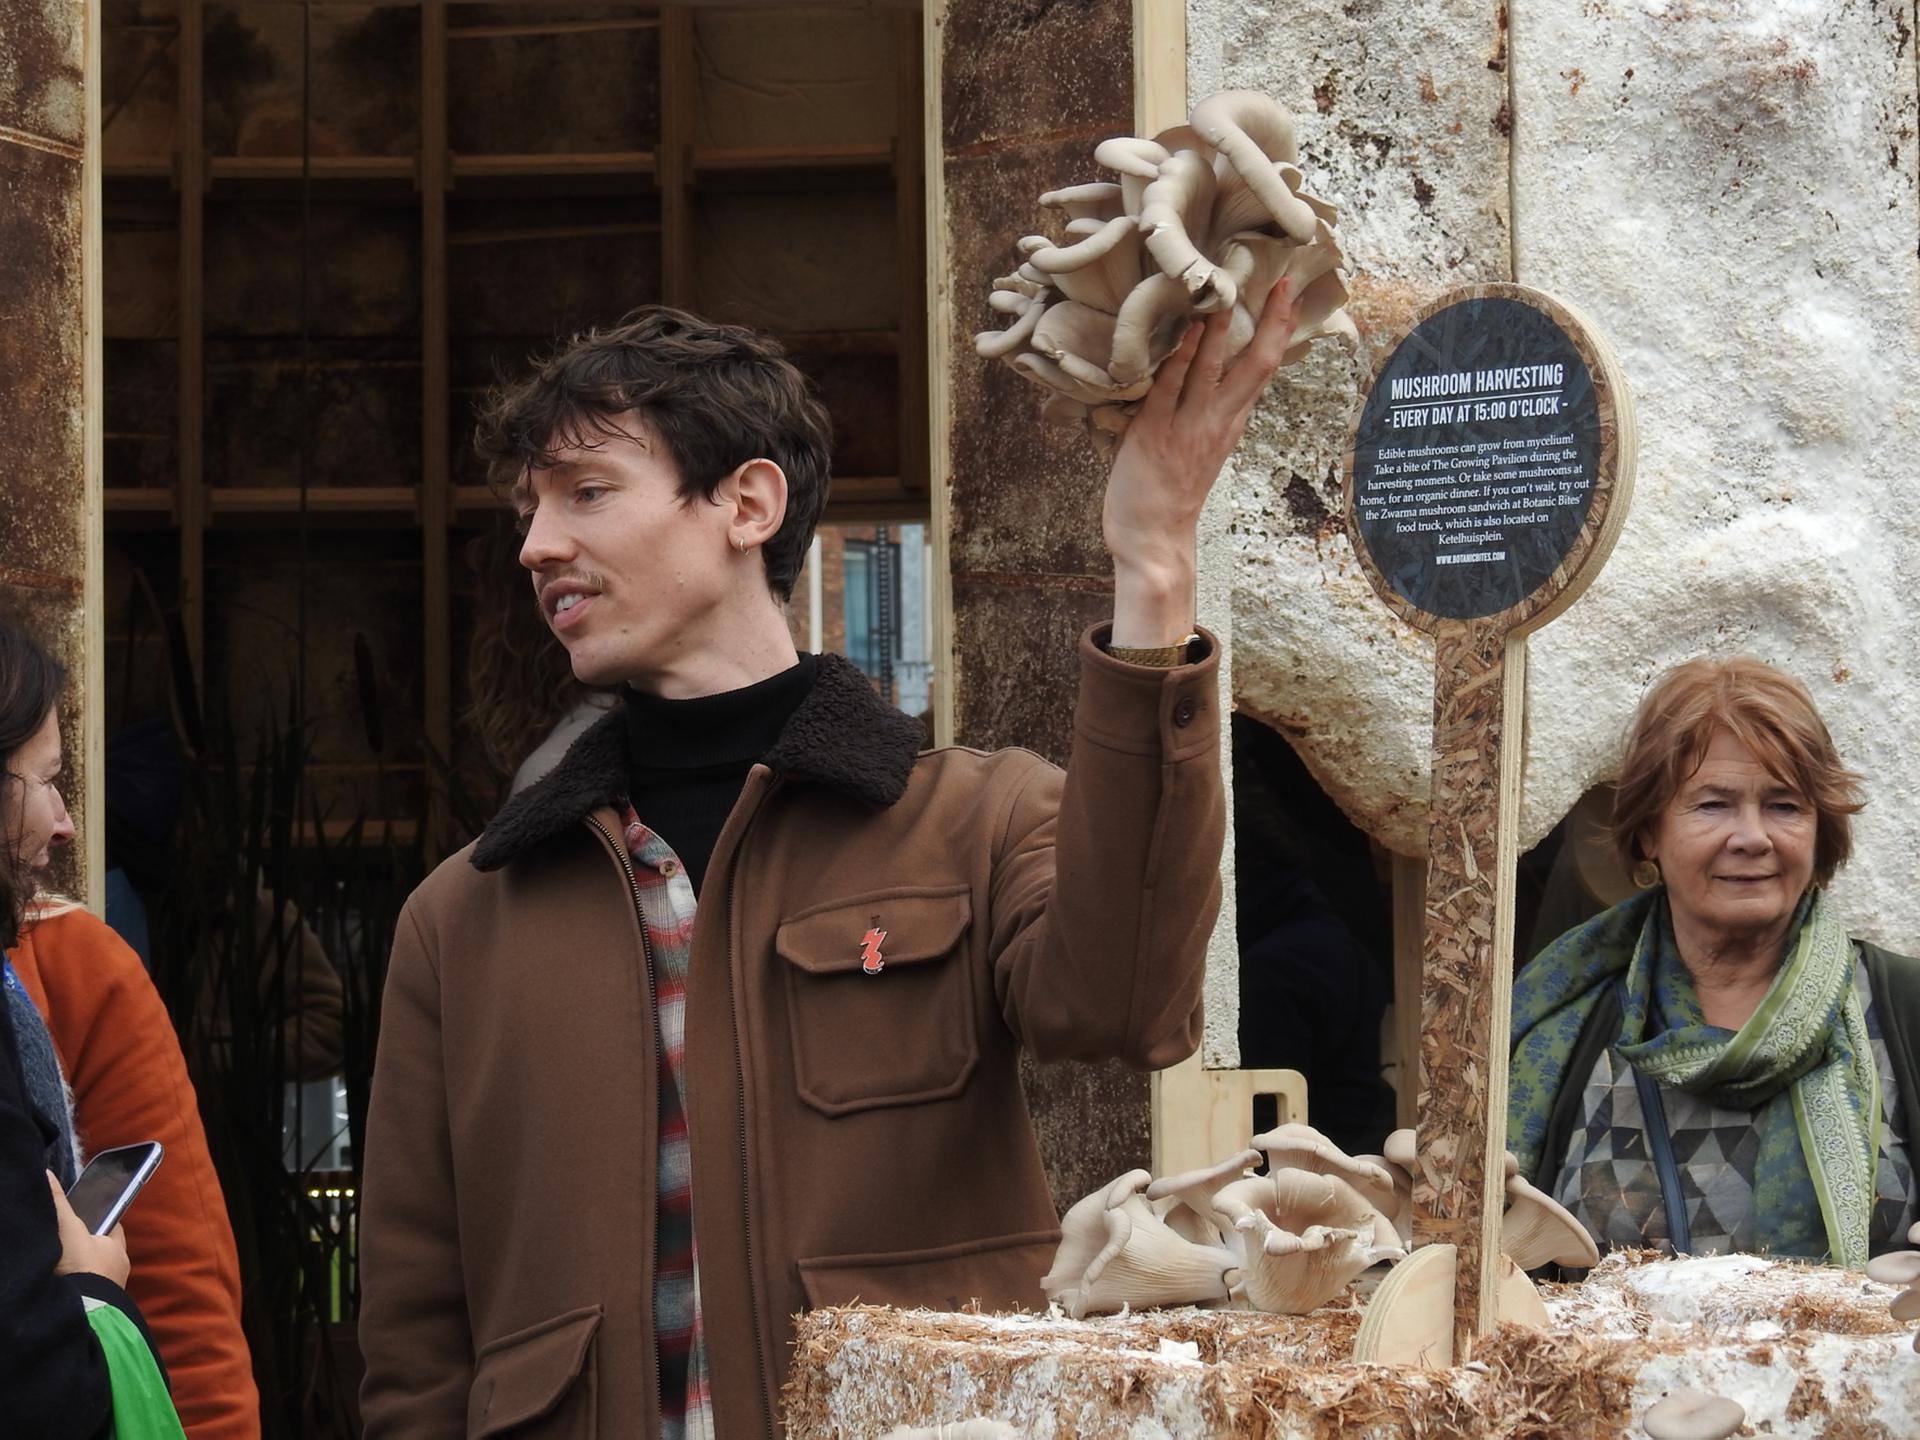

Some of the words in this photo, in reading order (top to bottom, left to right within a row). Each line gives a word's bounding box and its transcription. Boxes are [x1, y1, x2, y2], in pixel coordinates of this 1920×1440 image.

[1391, 372, 1471, 400] MUSHROOM
[1475, 363, 1564, 393] HARVESTING
[1392, 408, 1429, 429] EVERY
[1431, 406, 1454, 425] DAY
[1456, 404, 1471, 423] AT
[1474, 402, 1506, 421] 15:00
[1509, 396, 1559, 418] O'CLOCK
[1378, 448, 1406, 460] Edible
[1407, 445, 1459, 457] mushrooms
[1460, 444, 1476, 453] can
[1477, 441, 1501, 455] grow
[1502, 438, 1525, 450] from
[1526, 433, 1574, 450] mycelium!
[1374, 464, 1395, 475] Take
[1403, 461, 1420, 473] bite
[1421, 461, 1431, 471] of
[1432, 459, 1449, 470] The
[1450, 456, 1490, 470] Growing
[1492, 453, 1528, 466] Pavilion
[1529, 450, 1561, 463] during
[1562, 449, 1578, 460] the
[1367, 477, 1413, 491] harvesting
[1414, 475, 1457, 487] moments.
[1459, 472, 1471, 483] Or
[1473, 471, 1492, 482] take
[1493, 471, 1517, 480] some
[1519, 466, 1572, 479] mushrooms
[1573, 464, 1583, 474] at
[1360, 495, 1386, 506] home,
[1388, 493, 1401, 504] for
[1402, 494, 1414, 503] an
[1415, 490, 1448, 504] organic
[1450, 488, 1481, 499] dinner.
[1483, 485, 1492, 496] If
[1492, 486, 1509, 499] you
[1511, 482, 1533, 494] can't
[1535, 481, 1557, 492] wait,
[1559, 480, 1572, 493] try
[1573, 479, 1590, 489] out
[1365, 509, 1380, 520] the
[1380, 508, 1417, 520] Zwarma
[1419, 505, 1466, 516] mushroom
[1467, 500, 1511, 512] sandwich
[1512, 499, 1521, 509] at
[1522, 496, 1556, 508] Botanic
[1558, 493, 1583, 506] Bites'
[1396, 521, 1416, 533] food
[1418, 519, 1443, 531] truck,
[1445, 517, 1472, 529] which
[1474, 517, 1482, 527] is
[1483, 515, 1502, 526] also
[1503, 512, 1535, 525] located
[1537, 513, 1549, 523] on
[1438, 530, 1505, 546] Ketelhuisplein.
